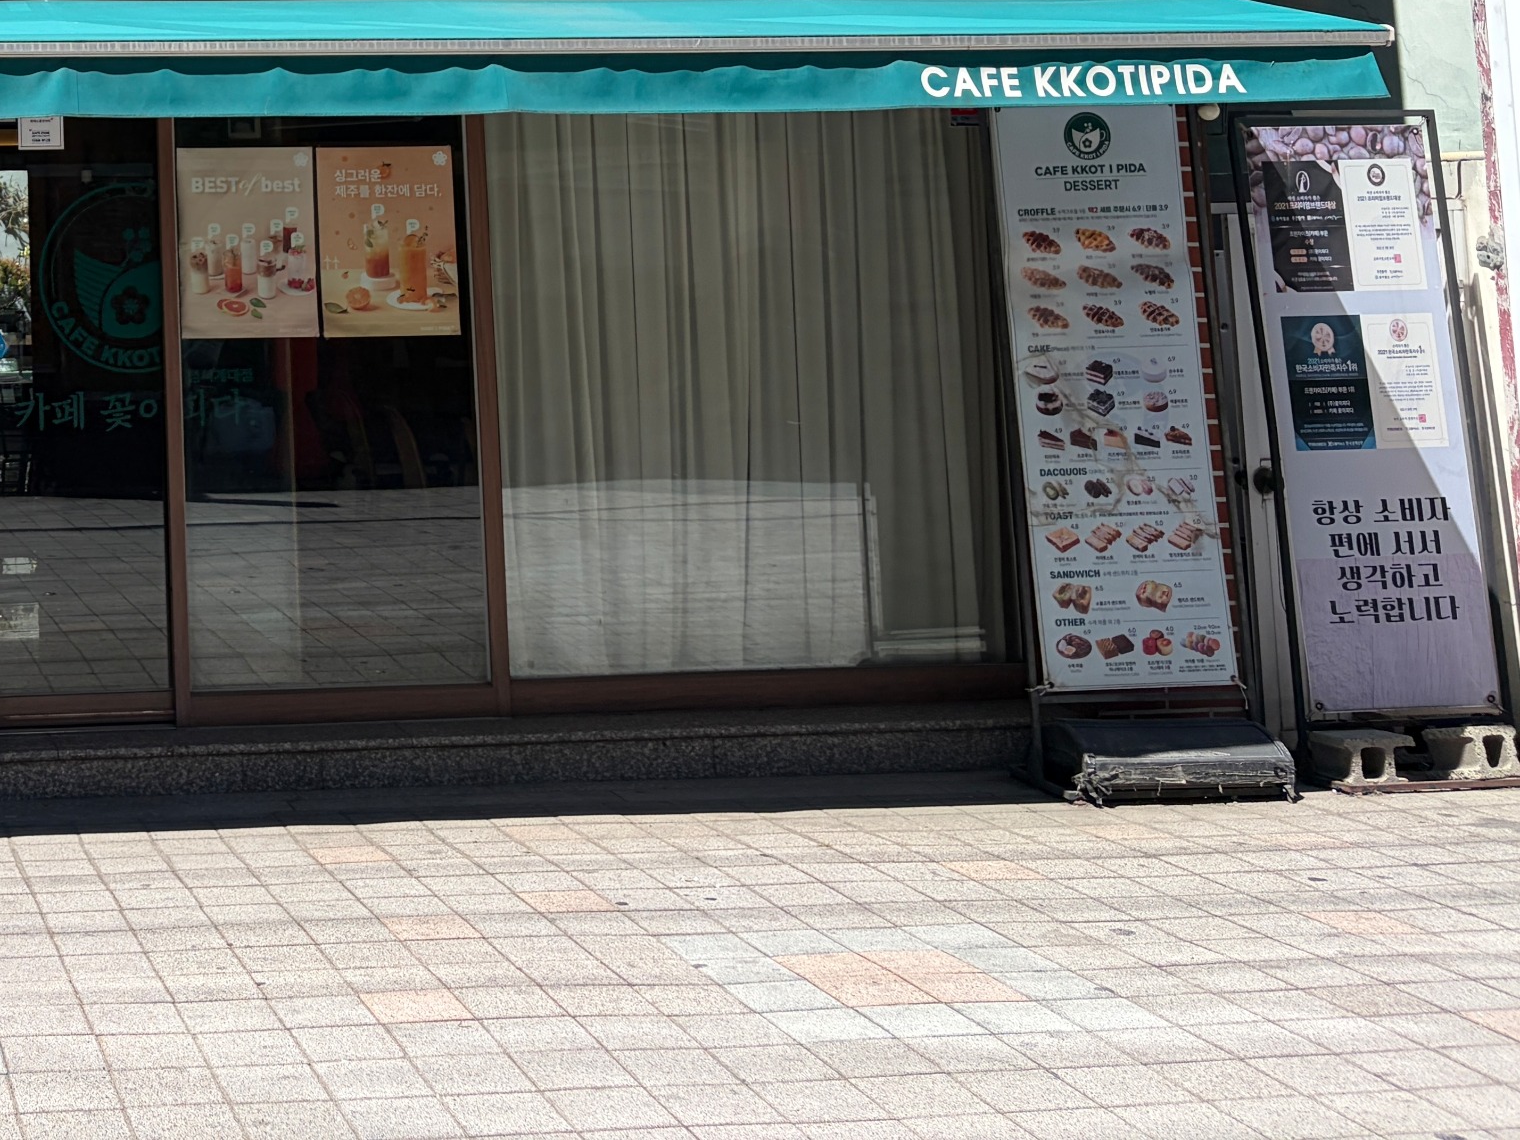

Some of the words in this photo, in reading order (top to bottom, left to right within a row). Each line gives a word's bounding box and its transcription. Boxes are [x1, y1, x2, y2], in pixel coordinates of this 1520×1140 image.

[920, 66, 1022, 98] CAFE
[1033, 64, 1247, 97] KKOTIPIDA
[334, 168, 382, 183] 싱그러운
[1035, 166, 1068, 176] CAFE
[1072, 165, 1105, 175] KKOT
[1117, 163, 1146, 174] PIDA
[191, 177, 239, 193] BEST
[261, 176, 301, 193] best
[335, 185, 370, 199] 제주를
[375, 184, 410, 198] 한잔에
[1064, 179, 1120, 192] DESSERT
[1018, 208, 1056, 217] CROFFLE
[1158, 204, 1169, 212] 3.9
[1274, 202, 1290, 210] 2021
[49, 300, 97, 360] CAFE
[100, 346, 162, 369] KKOT
[1028, 344, 1051, 353] CAKE
[15, 389, 86, 432] 카페
[1039, 467, 1088, 477] DACQUOIS
[1045, 511, 1074, 521] TOAST
[1311, 499, 1364, 526] 항상
[1373, 496, 1451, 524] 소비자
[1329, 532, 1381, 558] 편에
[1391, 530, 1443, 556] 서서
[1050, 569, 1101, 579] SANDWICH
[1336, 563, 1444, 592] 생각하고
[1329, 595, 1460, 624] 노력합니다
[1055, 618, 1086, 627] OTHER
